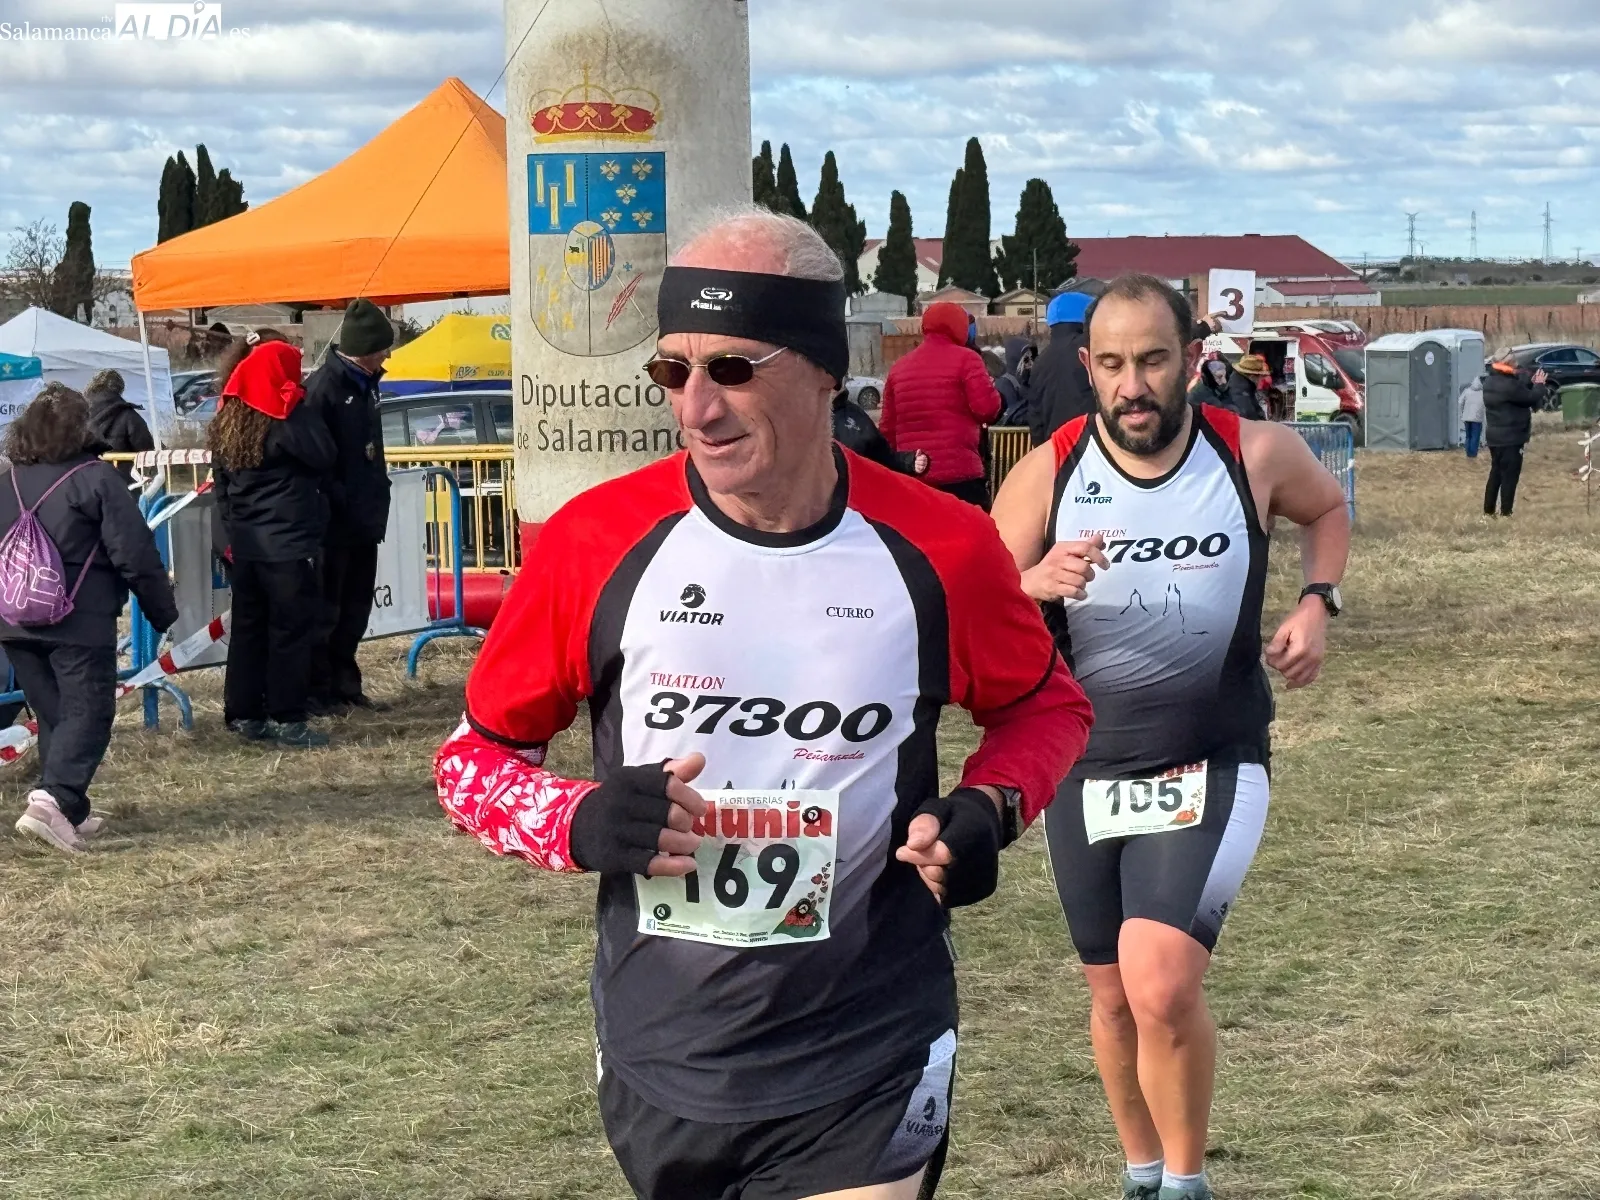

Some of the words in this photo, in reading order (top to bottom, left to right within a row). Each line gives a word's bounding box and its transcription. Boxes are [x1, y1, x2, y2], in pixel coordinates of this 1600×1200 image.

[1219, 287, 1245, 321] 3
[521, 374, 668, 414] Diputacio
[517, 425, 529, 450] de
[537, 418, 687, 452] Salamanc
[1074, 496, 1112, 504] VIATOR
[1101, 532, 1231, 564] 7300
[659, 609, 724, 626] VIATOR
[826, 606, 874, 619] CURRO
[650, 672, 725, 690] TRIATLON
[644, 691, 893, 743] 37300
[792, 747, 866, 762] Peñaranda
[1105, 776, 1183, 817] 105
[692, 800, 832, 839] dunia
[684, 843, 800, 909] 169
